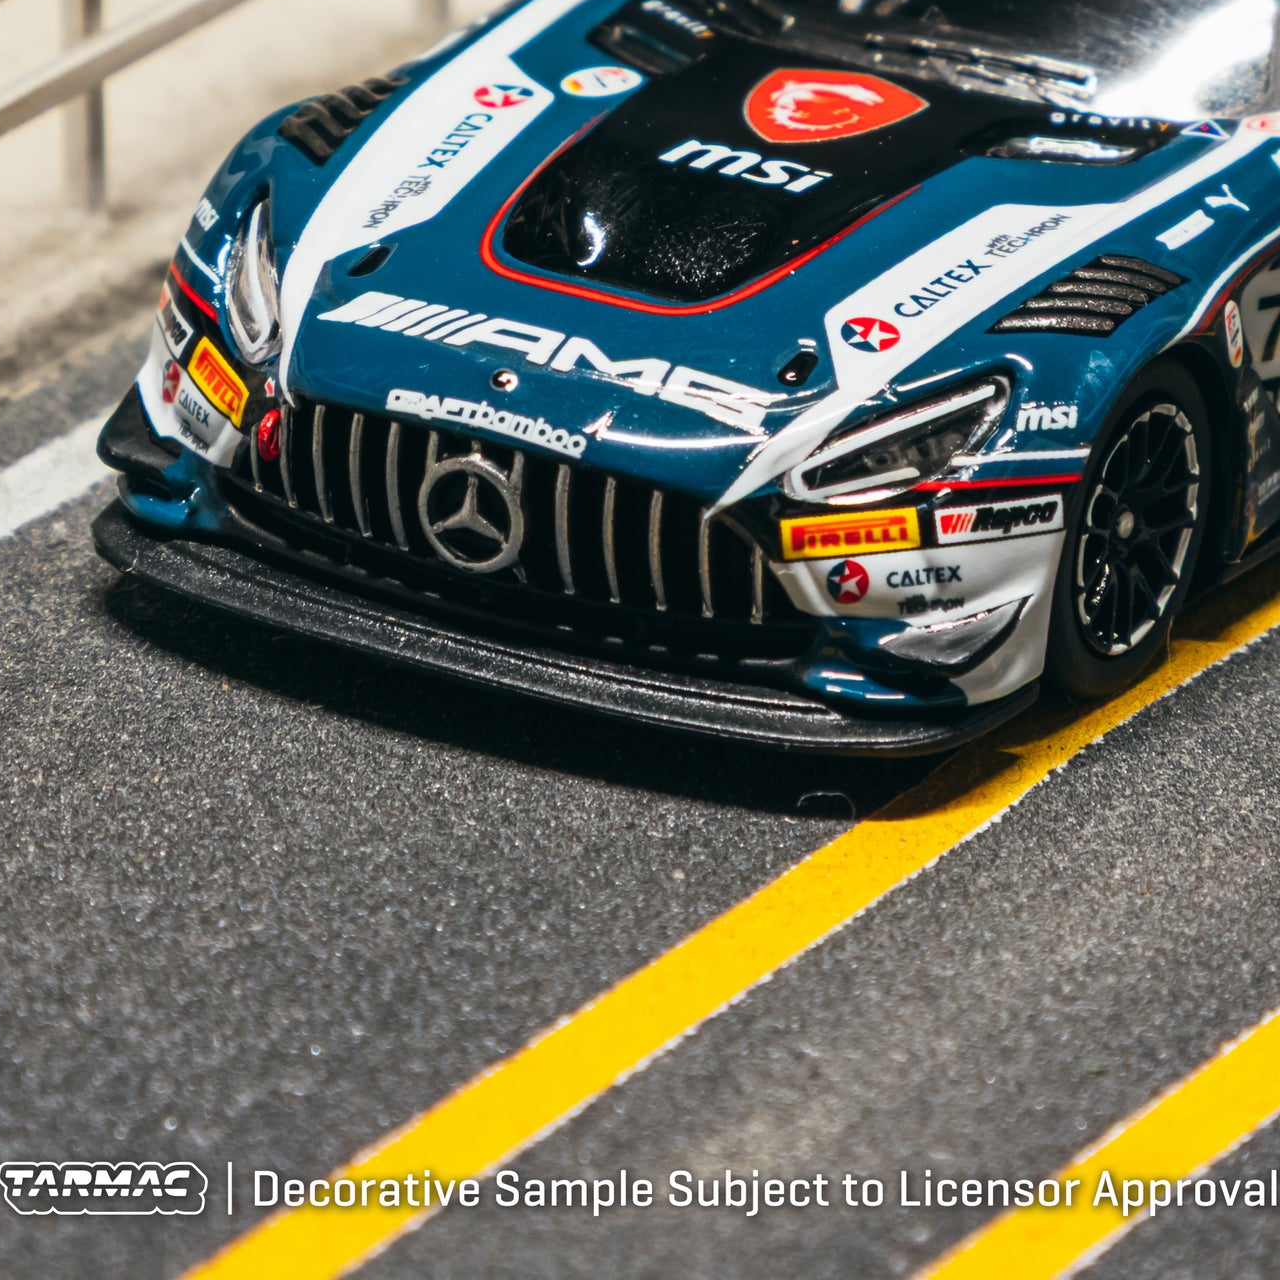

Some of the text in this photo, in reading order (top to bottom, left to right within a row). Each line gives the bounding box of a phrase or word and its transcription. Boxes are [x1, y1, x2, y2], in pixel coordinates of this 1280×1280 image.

[417, 113, 494, 168] CALTEX
[658, 139, 833, 193] msi
[894, 259, 993, 317] CALTEX
[444, 318, 787, 435] AMG
[178, 388, 211, 429] CALTEX
[1016, 404, 1078, 431] msi
[791, 516, 908, 551] PIRELLI
[971, 501, 1058, 535] Repco
[887, 565, 962, 589] CALTEX
